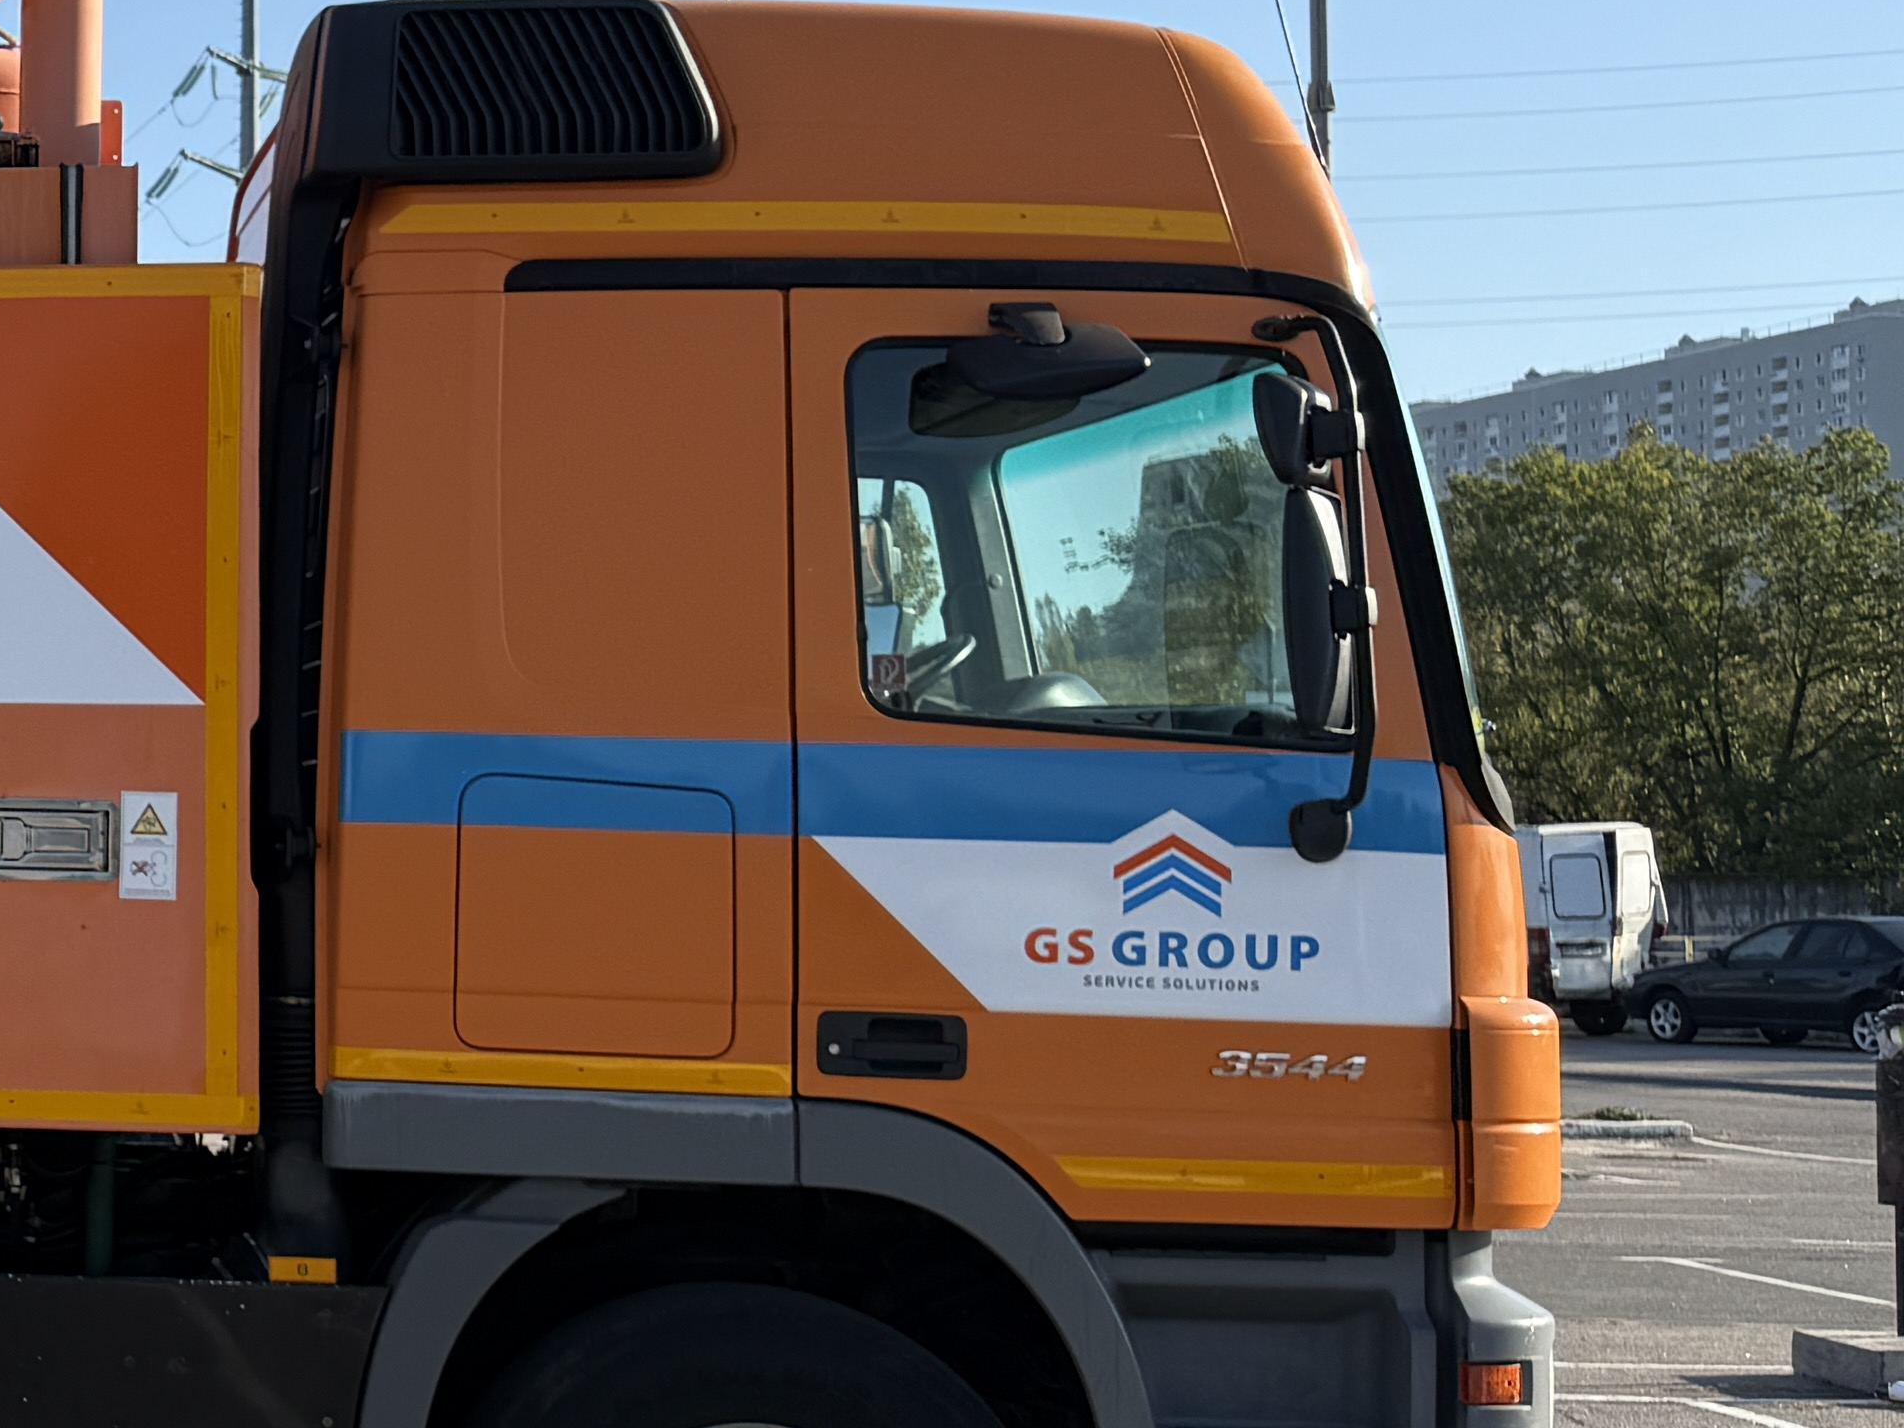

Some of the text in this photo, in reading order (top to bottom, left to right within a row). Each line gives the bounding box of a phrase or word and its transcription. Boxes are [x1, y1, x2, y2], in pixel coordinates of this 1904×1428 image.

[1024, 927, 1321, 972] GS GROUP
[1082, 974, 1260, 992] SERVICE SOLUTIONS
[1210, 1049, 1367, 1083] 3544
